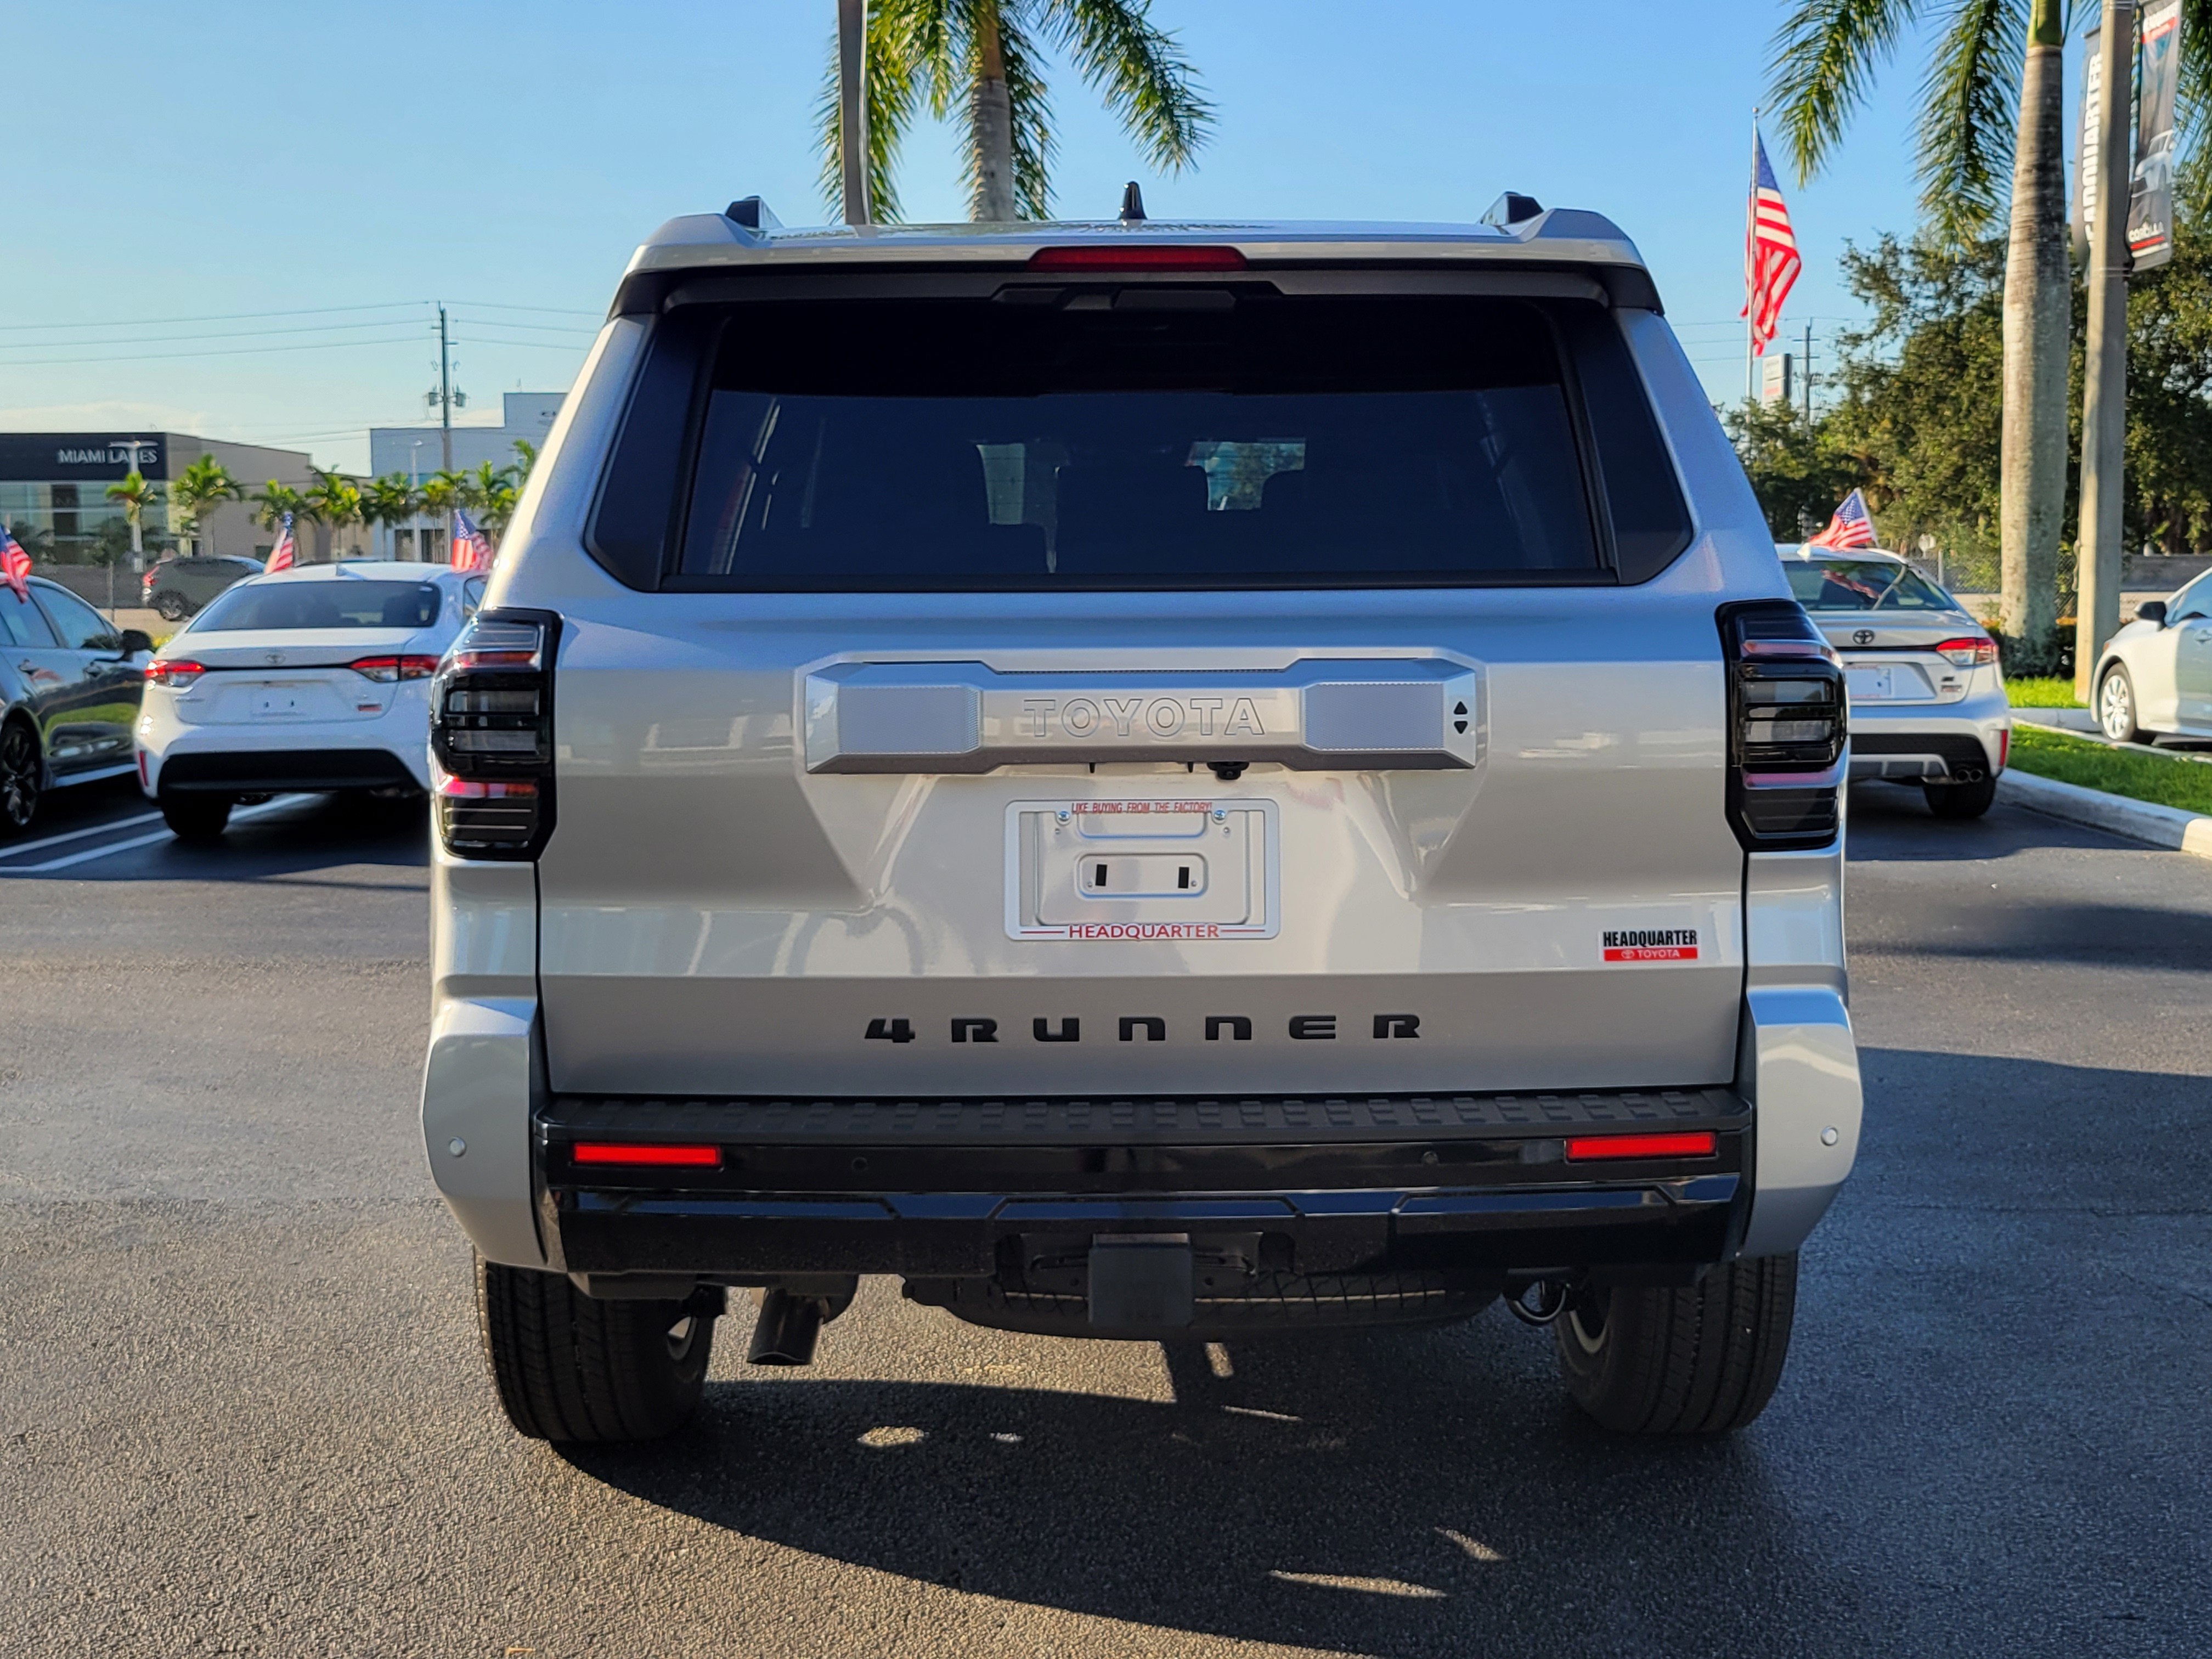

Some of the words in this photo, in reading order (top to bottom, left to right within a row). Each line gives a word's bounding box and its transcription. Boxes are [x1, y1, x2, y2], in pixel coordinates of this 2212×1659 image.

[58, 448, 106, 464] MIAMI
[109, 448, 157, 464] LAES
[1023, 697, 1266, 738] TOYOTA
[1071, 803, 1088, 813] LIKE
[1092, 803, 1122, 813] BUYING
[1127, 803, 1150, 813] FROM
[1154, 803, 1169, 813] THE
[1069, 924, 1220, 939] HEADQUARTER
[1602, 929, 1697, 947] HEADQUARTER
[1637, 949, 1680, 958] TOYOTA
[864, 1013, 1421, 1044] 4RUNNER
